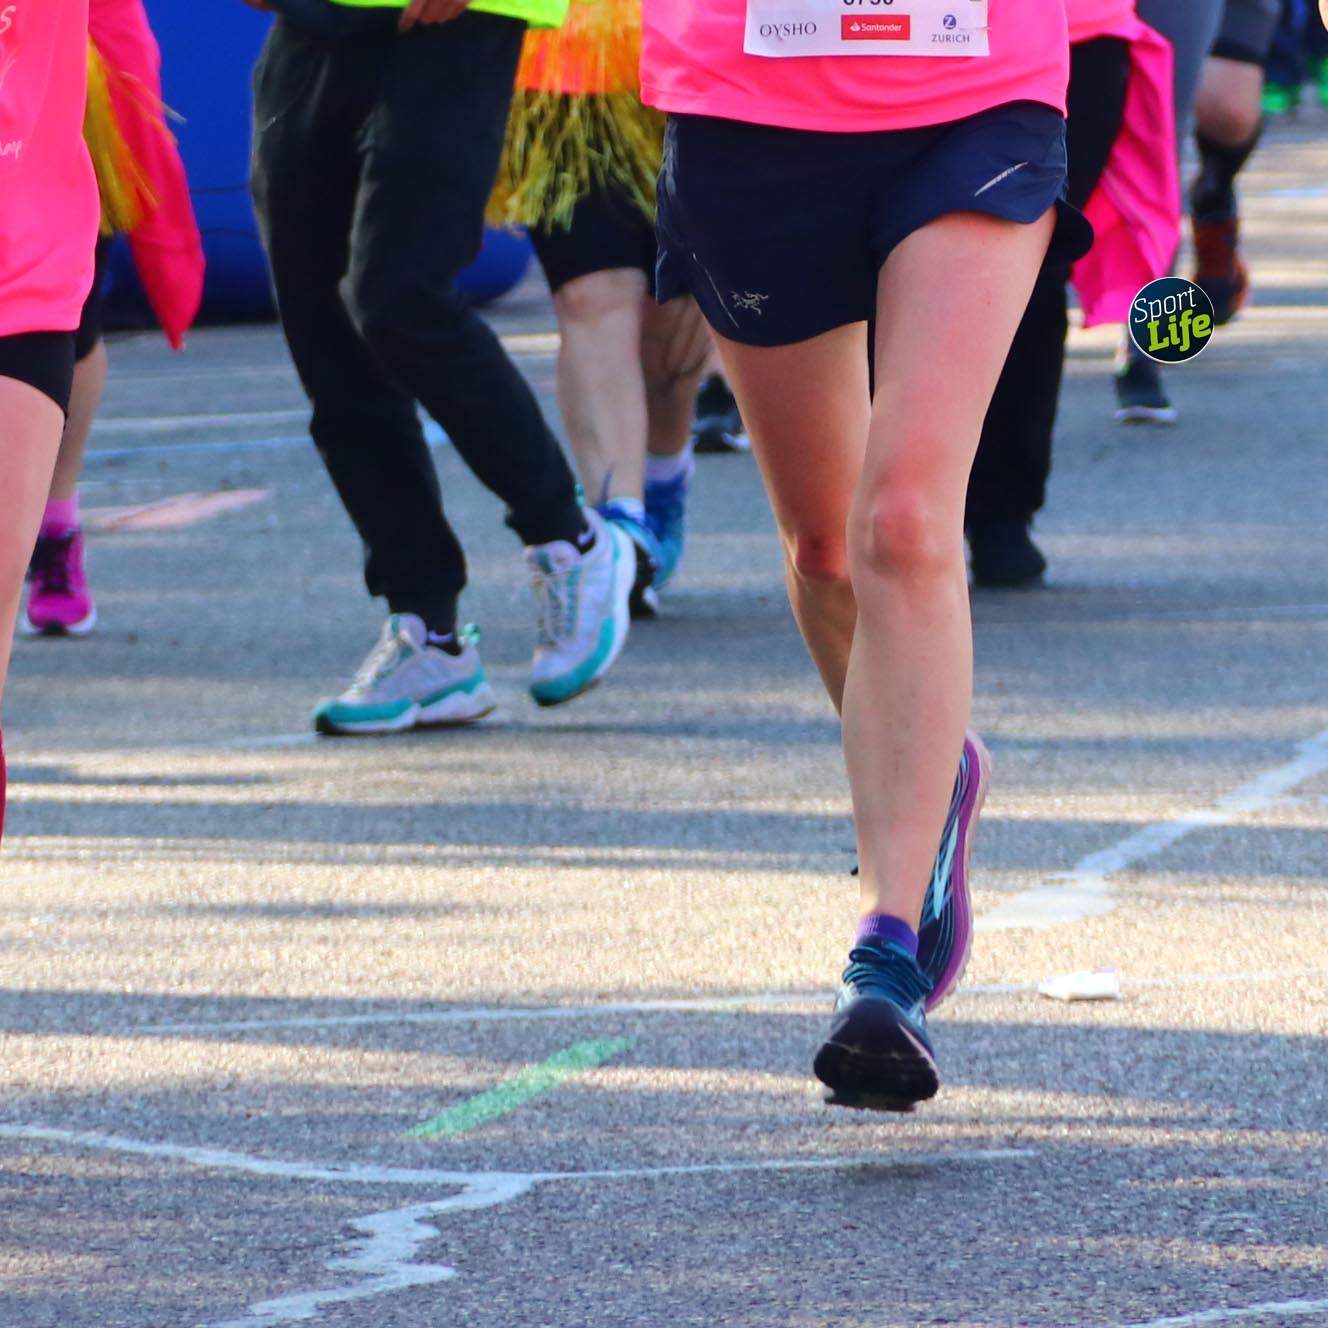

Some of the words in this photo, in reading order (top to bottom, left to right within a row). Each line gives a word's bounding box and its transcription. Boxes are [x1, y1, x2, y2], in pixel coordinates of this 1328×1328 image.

[759, 21, 817, 38] OYSHO
[861, 22, 903, 33] Santander
[931, 34, 971, 43] ZURICH
